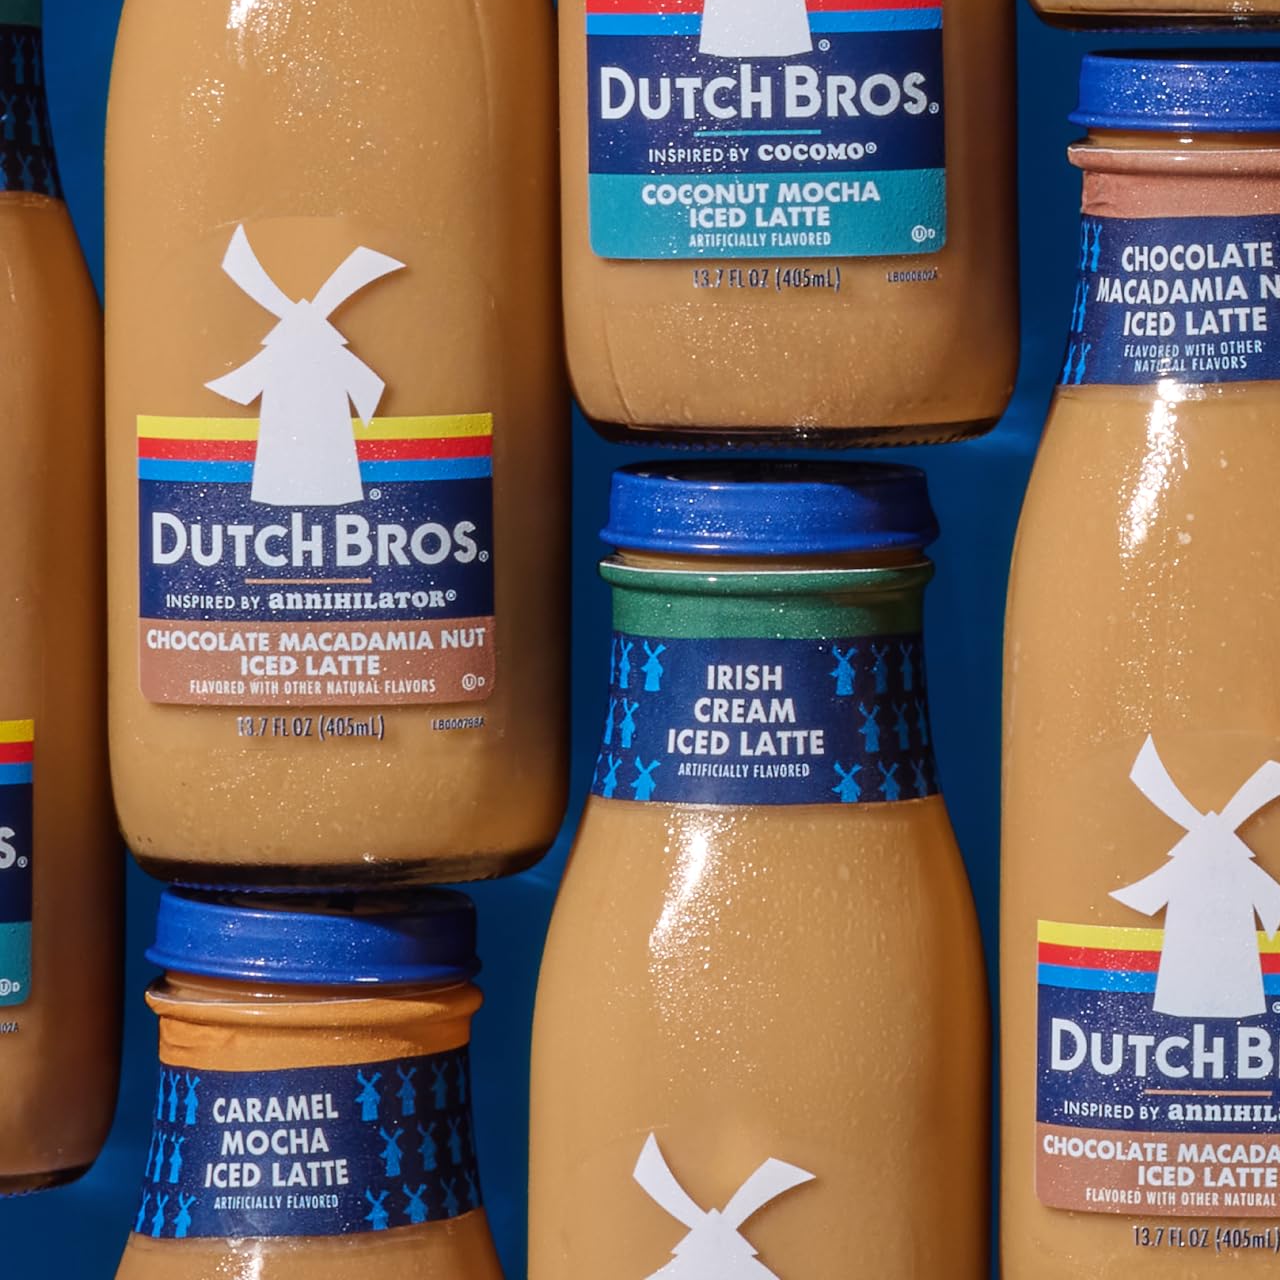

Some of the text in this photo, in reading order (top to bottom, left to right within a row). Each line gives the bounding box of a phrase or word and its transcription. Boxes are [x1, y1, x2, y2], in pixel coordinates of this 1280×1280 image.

[649, 149, 725, 163] INSPIRED
[729, 149, 749, 162] BY
[642, 181, 880, 205] COCONUT MOCHA
[690, 207, 830, 228] ICED LATTE
[689, 232, 831, 247] ARTIFICIALLY FLAVORED
[1122, 242, 1273, 272] CHOCOLATE
[1096, 276, 1248, 304] MACADAMIA
[1123, 308, 1267, 336] ICED LATTE
[166, 594, 260, 609] INSPIRED BY
[147, 628, 485, 651] CHOCOLATE MACADAMIA NUT
[240, 656, 380, 676] ICED LATTE
[707, 665, 782, 690] IRISH
[694, 698, 796, 723] CREAM
[667, 729, 824, 756] ICED LATTE
[678, 763, 810, 778] ARTIFICIALLY FLAVORED
[213, 1094, 338, 1123] CARAMEL
[1064, 1101, 1134, 1118] INSPIRED
[1140, 1106, 1159, 1119] BY
[221, 1129, 329, 1156] MOCHA
[1043, 1135, 1168, 1162] CHOCOLATE
[205, 1159, 349, 1188] ICED LATTE
[1138, 1166, 1278, 1188] ICED LATTE
[1086, 1189, 1141, 1204] FLAVORED
[1147, 1192, 1176, 1205] WITH
[1182, 1192, 1219, 1206] OTHER
[1224, 1193, 1276, 1206] NATURAL
[1132, 1227, 1164, 1247] 13.7
[1168, 1228, 1185, 1247] FL
[1189, 1229, 1209, 1248] OZ
